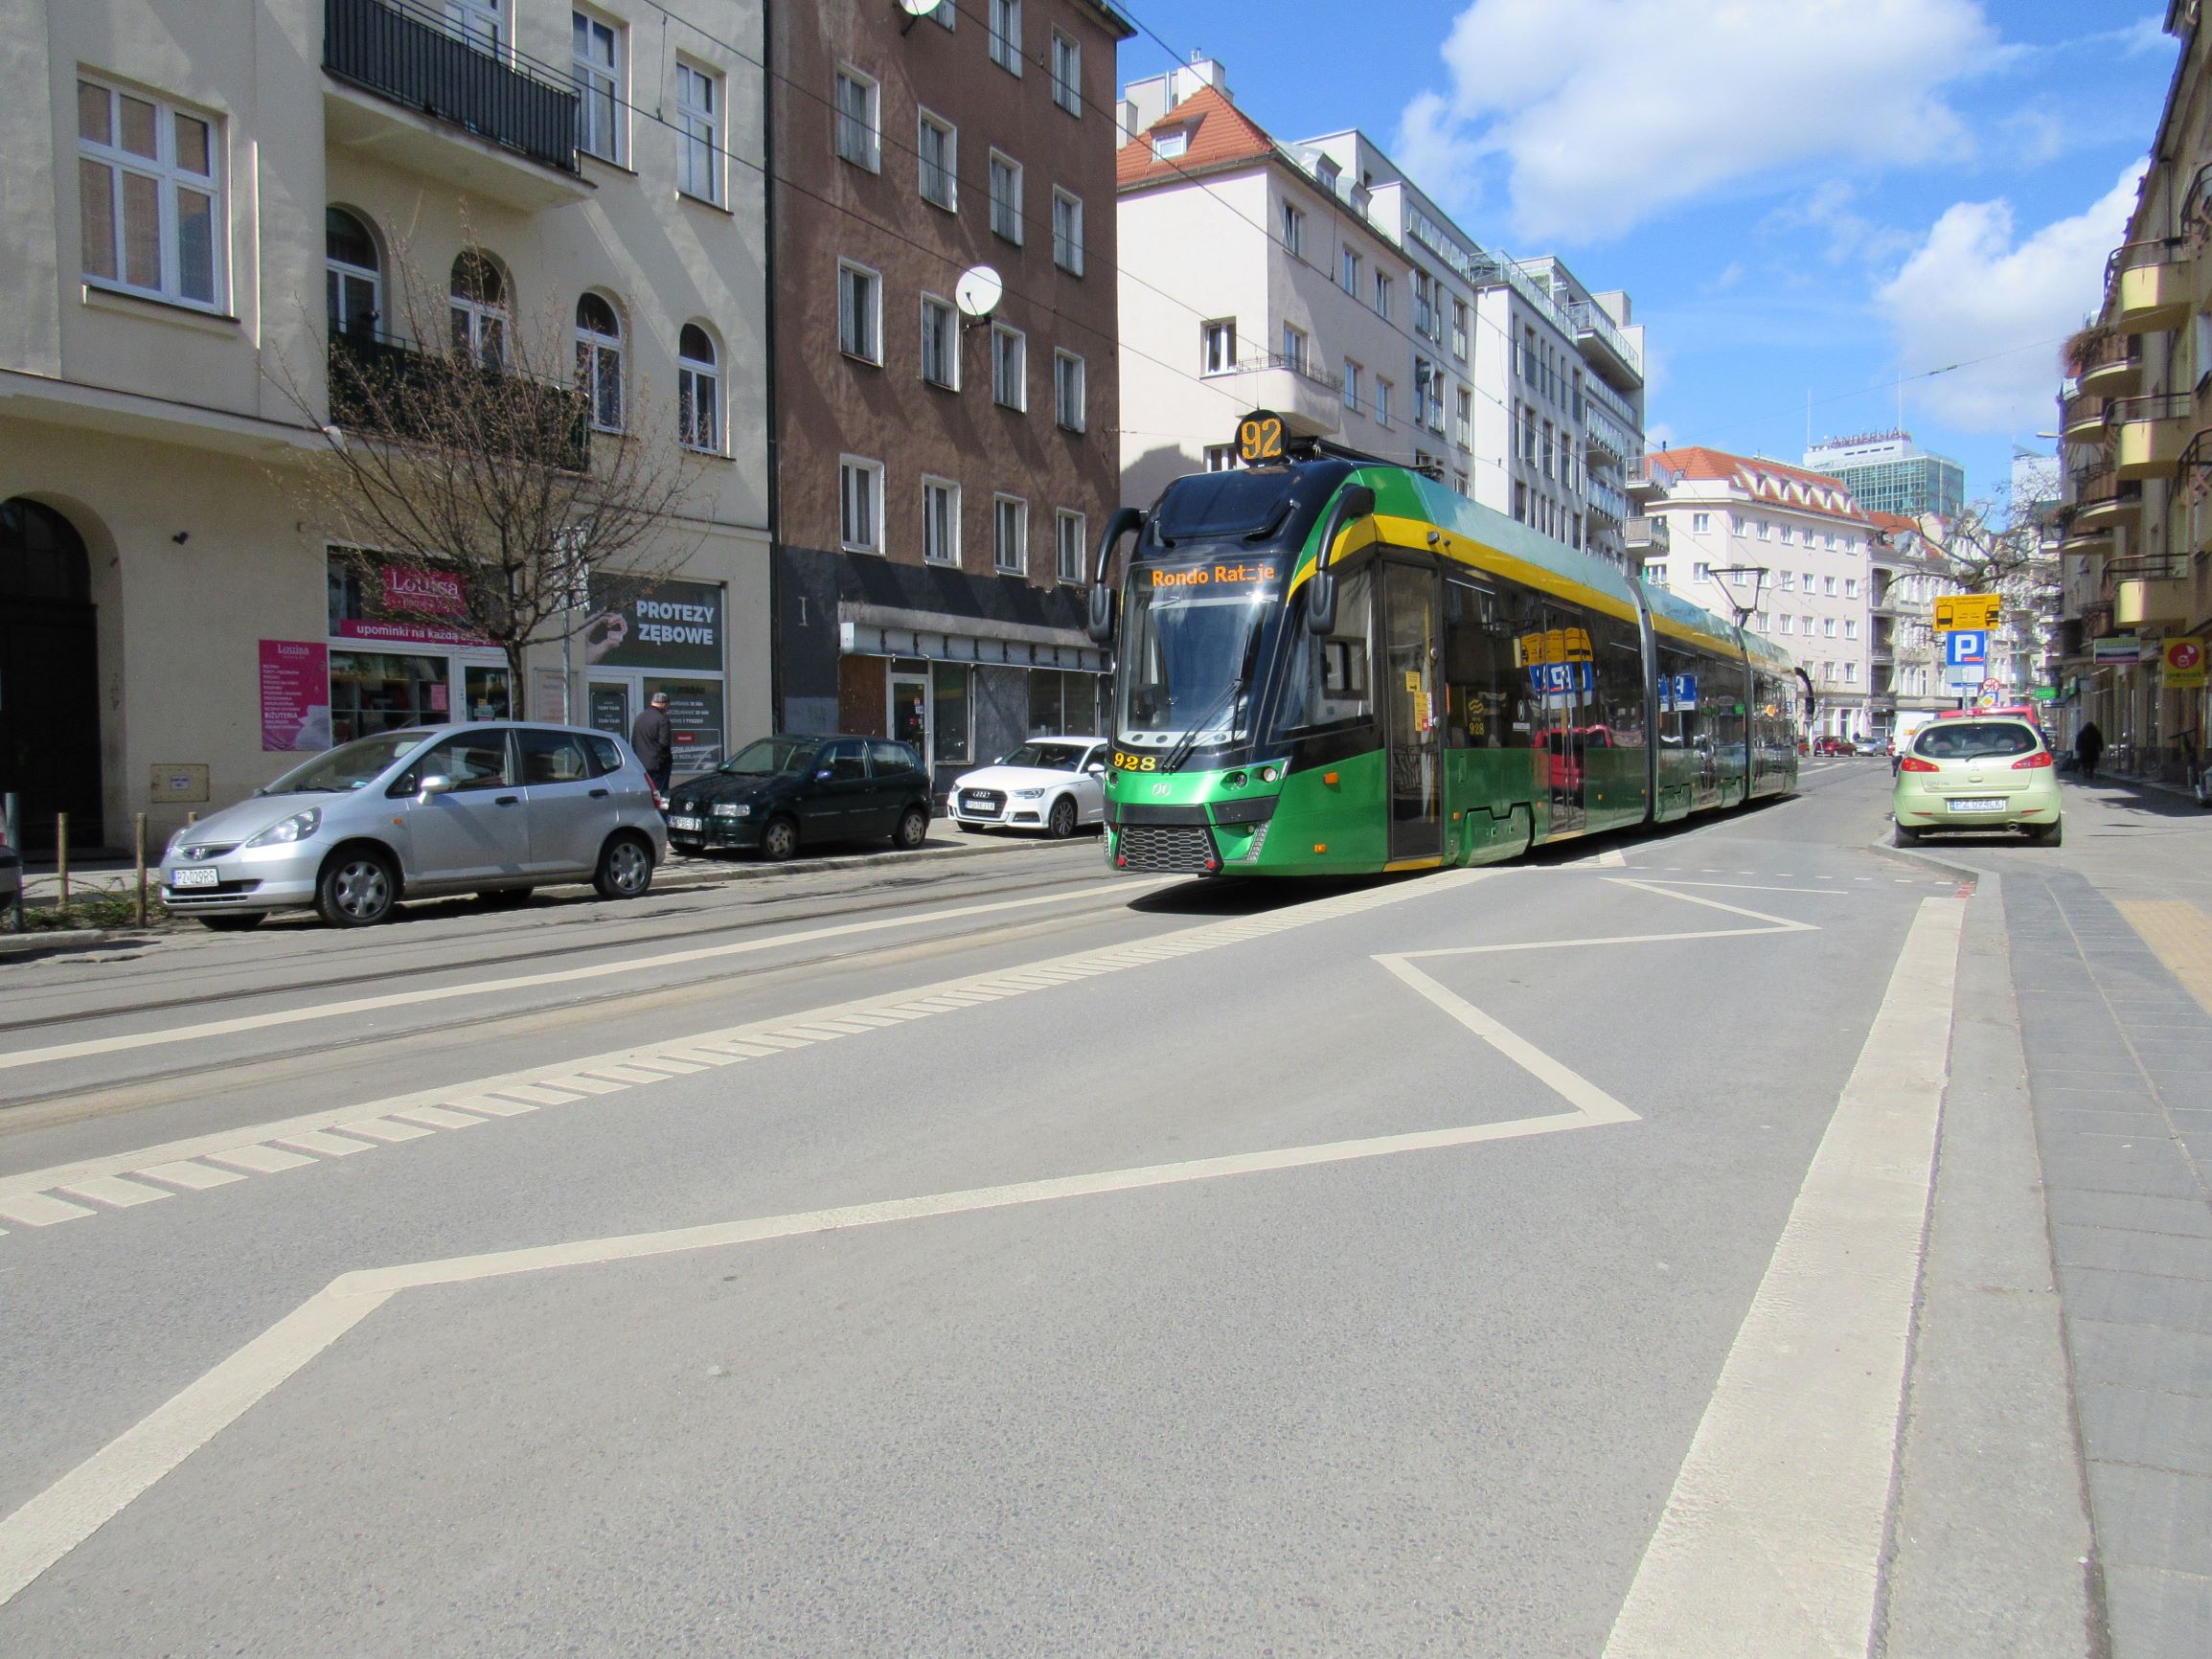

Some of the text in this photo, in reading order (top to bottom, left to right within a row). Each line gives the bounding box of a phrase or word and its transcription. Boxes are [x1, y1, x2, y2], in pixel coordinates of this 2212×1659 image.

[1242, 418, 1282, 459] 92
[1831, 427, 1902, 449] ANDERSIA
[391, 571, 459, 596] Louisa
[1152, 567, 1209, 587] Rondo
[636, 600, 715, 624] PROTEZY
[356, 625, 409, 636] upominki
[412, 628, 425, 638] na
[638, 624, 714, 646] ZĘBOWE
[277, 644, 309, 655] Louisa
[1954, 634, 1977, 662] P
[1114, 753, 1156, 771] 928
[177, 870, 216, 884] PZ 029RS
